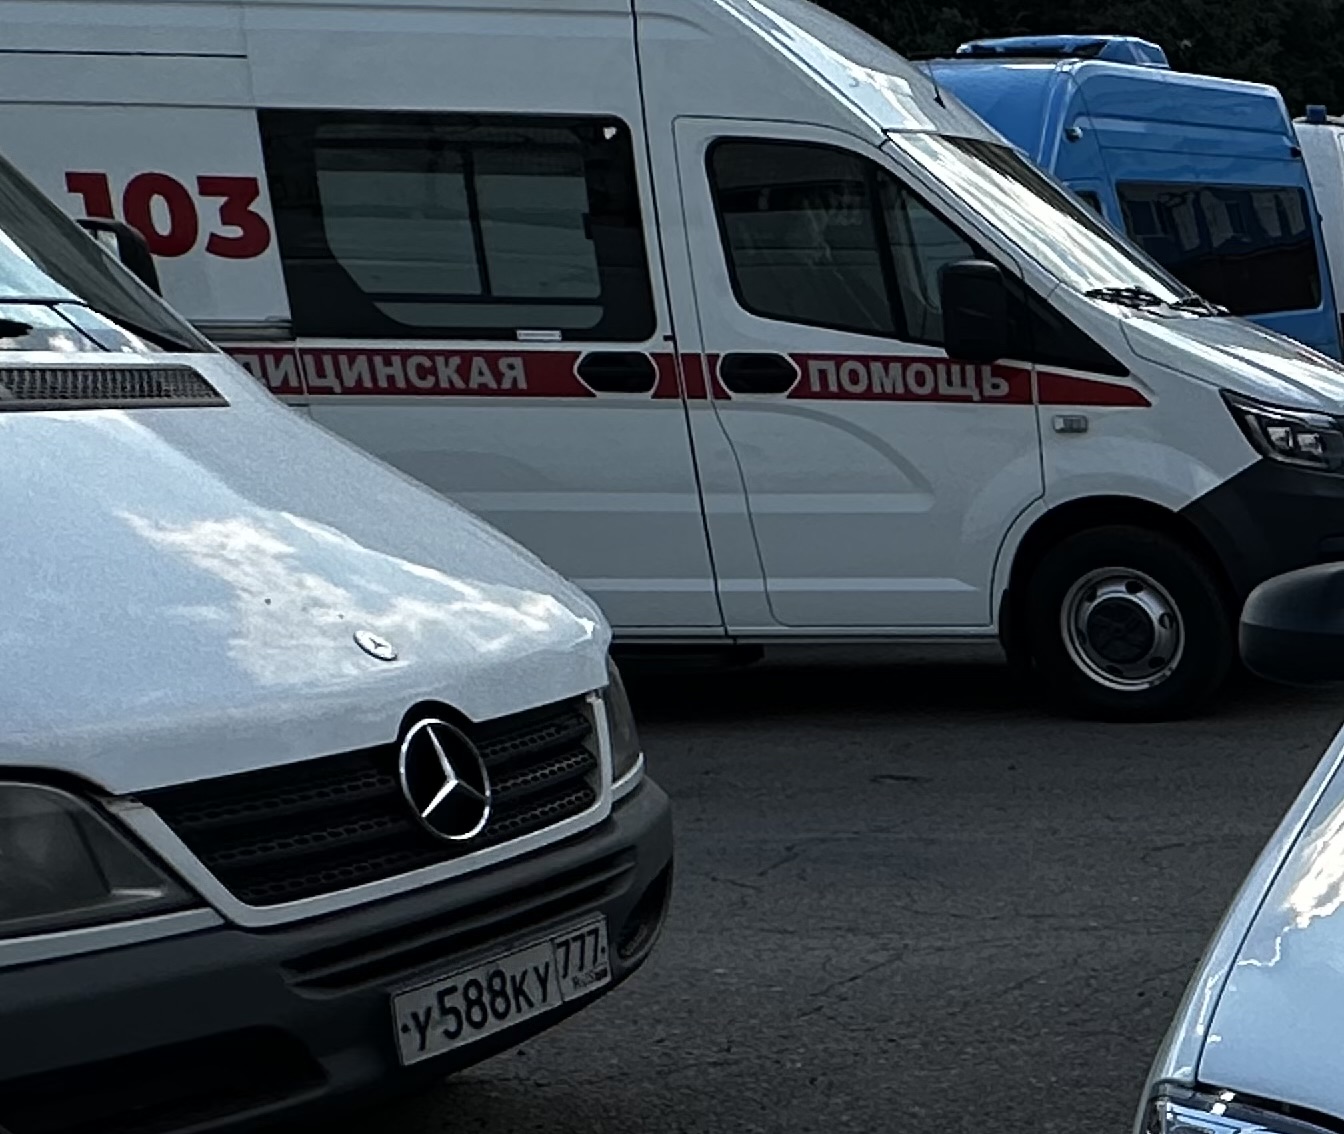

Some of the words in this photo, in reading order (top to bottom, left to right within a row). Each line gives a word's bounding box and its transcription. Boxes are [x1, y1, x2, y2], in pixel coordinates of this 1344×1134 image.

[65, 172, 271, 259] 103
[807, 360, 1010, 401] ПОМОЩЬ
[556, 927, 600, 980] 777
